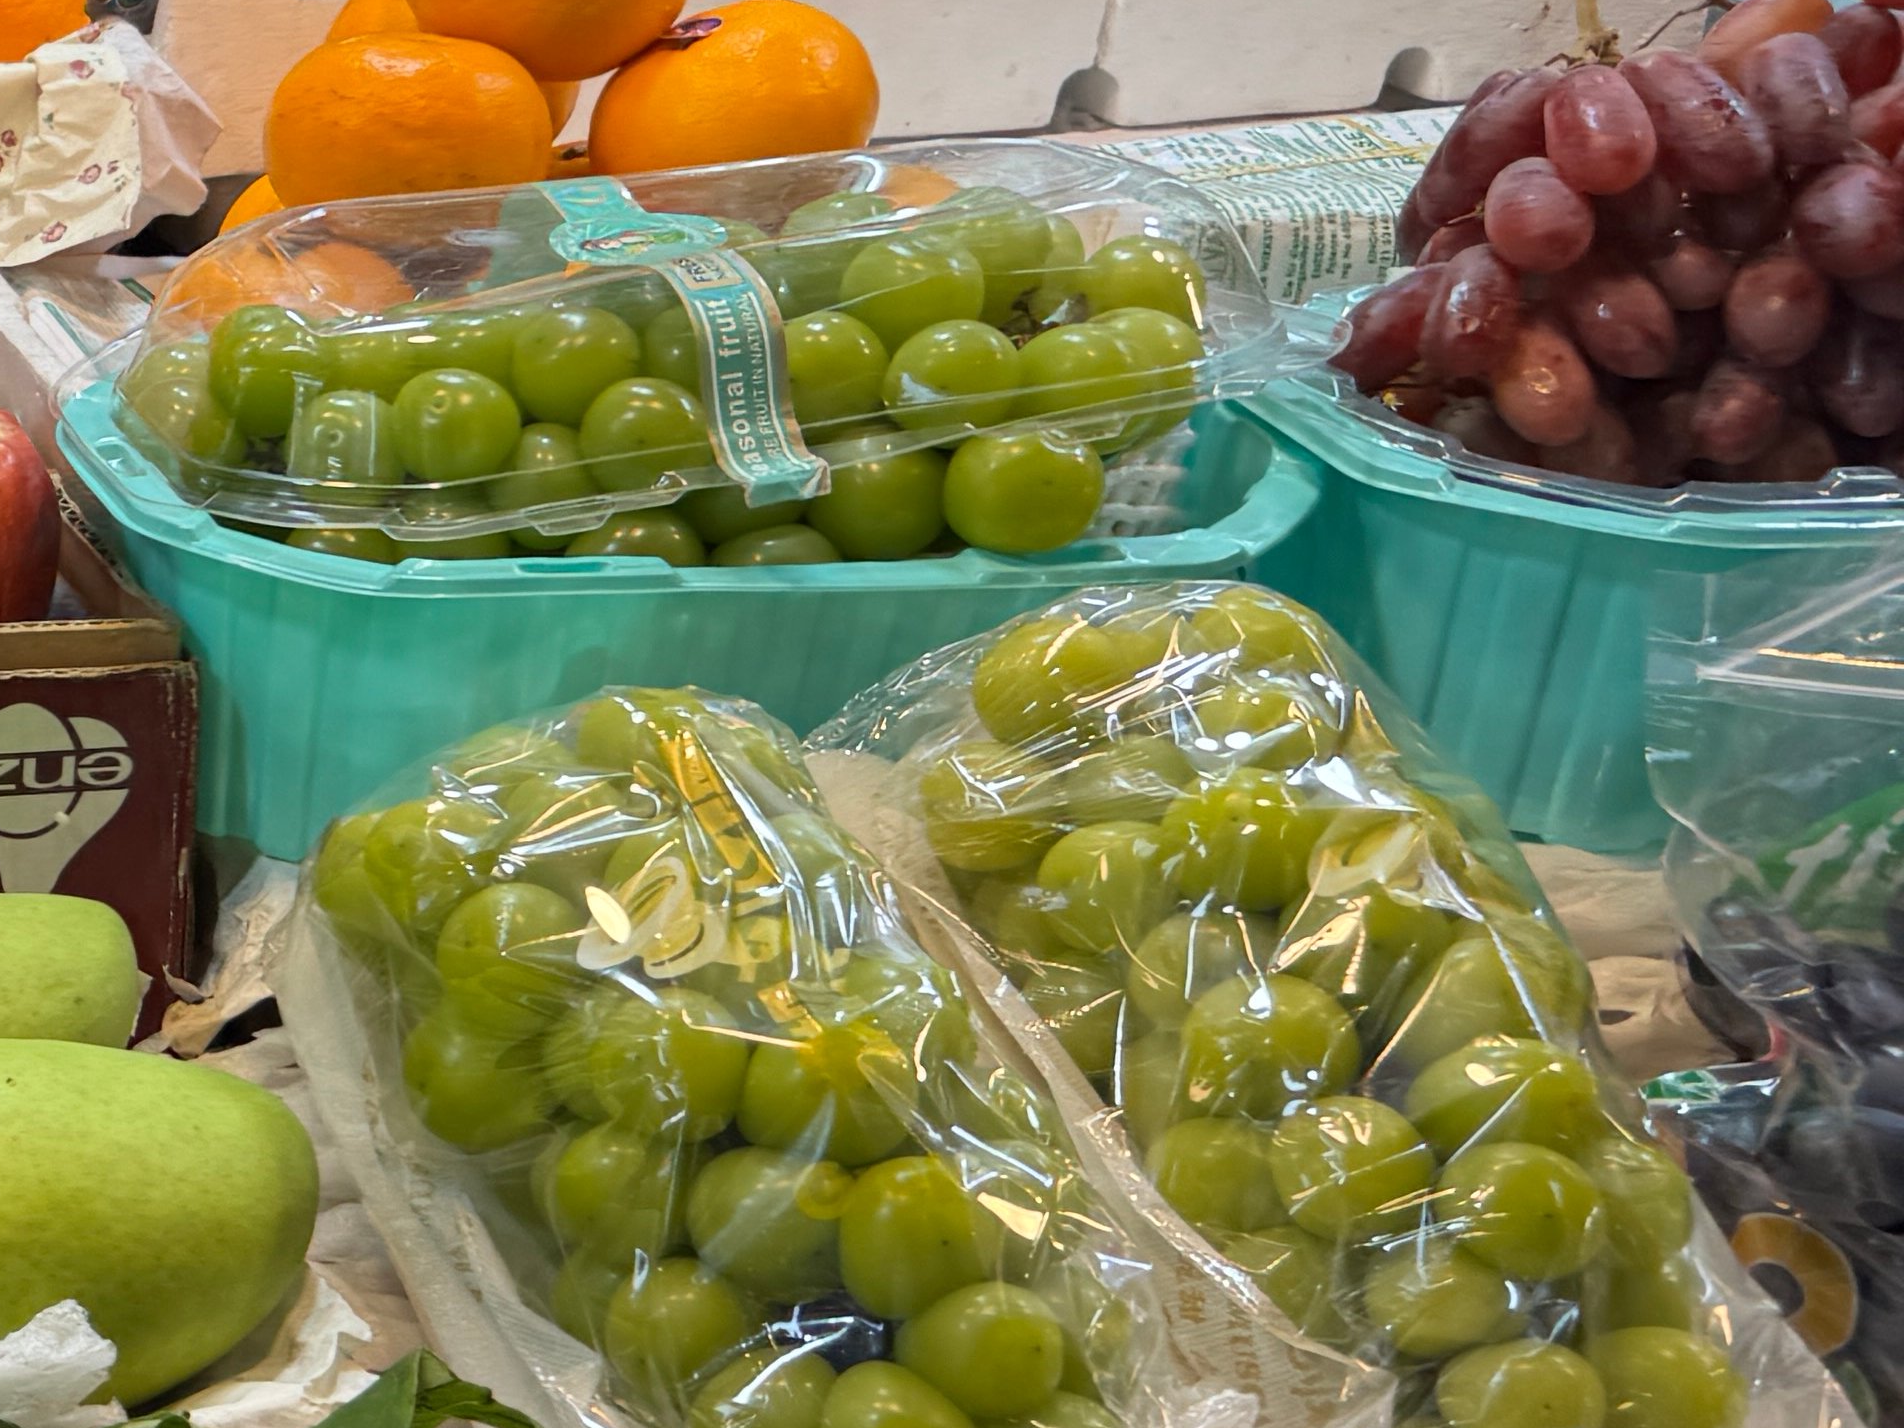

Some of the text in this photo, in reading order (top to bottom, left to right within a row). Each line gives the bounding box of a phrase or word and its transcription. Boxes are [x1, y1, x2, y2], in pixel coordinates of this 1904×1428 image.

[736, 291, 765, 367] NATURAL
[704, 298, 770, 478] easonal fruit
[753, 382, 775, 439] FRUIT
